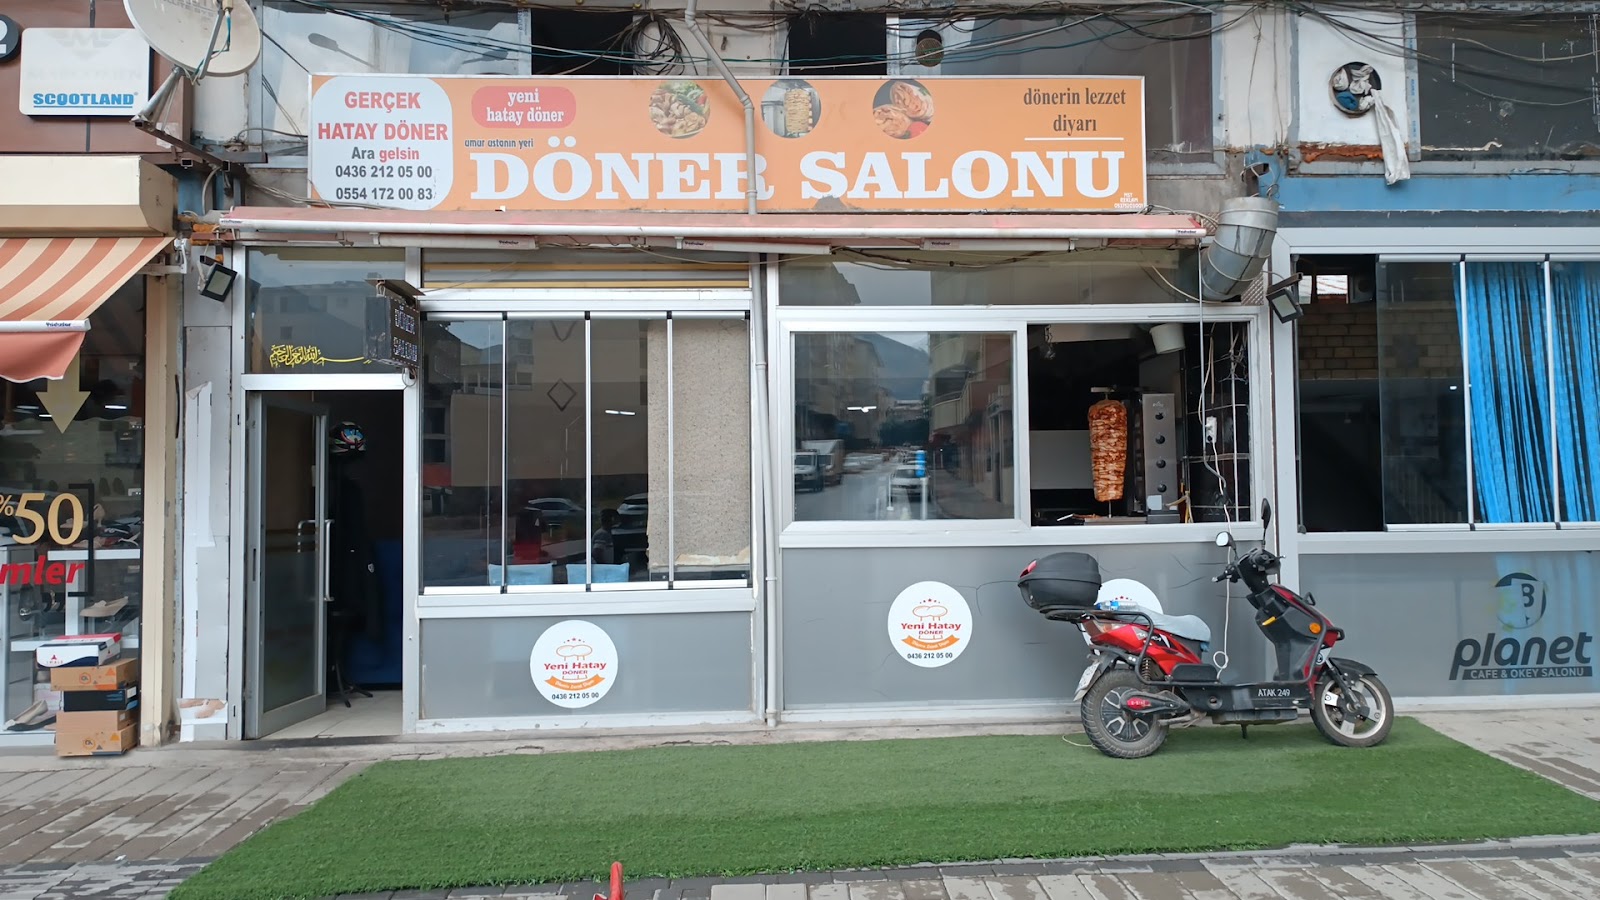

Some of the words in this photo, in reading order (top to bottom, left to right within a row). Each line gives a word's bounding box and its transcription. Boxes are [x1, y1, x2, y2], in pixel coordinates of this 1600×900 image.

[344, 91, 421, 113] GERÇEK
[508, 88, 540, 106] yeni
[1023, 88, 1080, 105] dönerin
[1085, 88, 1126, 105] lezzet
[486, 107, 523, 126] hatay
[527, 107, 564, 122] döner
[1053, 114, 1097, 136] diyarı
[318, 122, 378, 140] HATAY
[384, 119, 449, 140] DÖNER
[518, 138, 534, 149] yeri
[351, 146, 375, 160] Ara
[379, 147, 420, 163] gelsin
[335, 165, 367, 178] 0436
[370, 165, 394, 178] 212
[398, 165, 413, 178] 05
[417, 165, 432, 178] 00
[470, 136, 773, 201] DÖNER
[799, 150, 1125, 200] SALONU
[335, 187, 367, 200] 0554
[371, 187, 395, 200] 172
[398, 187, 413, 200] 00
[417, 187, 433, 200] 83
[901, 622, 925, 630] Yeni
[928, 622, 961, 631] Hatay
[1449, 632, 1593, 681] planet
[544, 662, 568, 670] Yeni
[572, 662, 607, 671] Hatay
[1470, 669, 1498, 679] CAFE
[1500, 669, 1509, 678] &
[1510, 669, 1539, 678] OKEY
[1542, 667, 1584, 677] SALONU
[1278, 688, 1290, 696] 249
